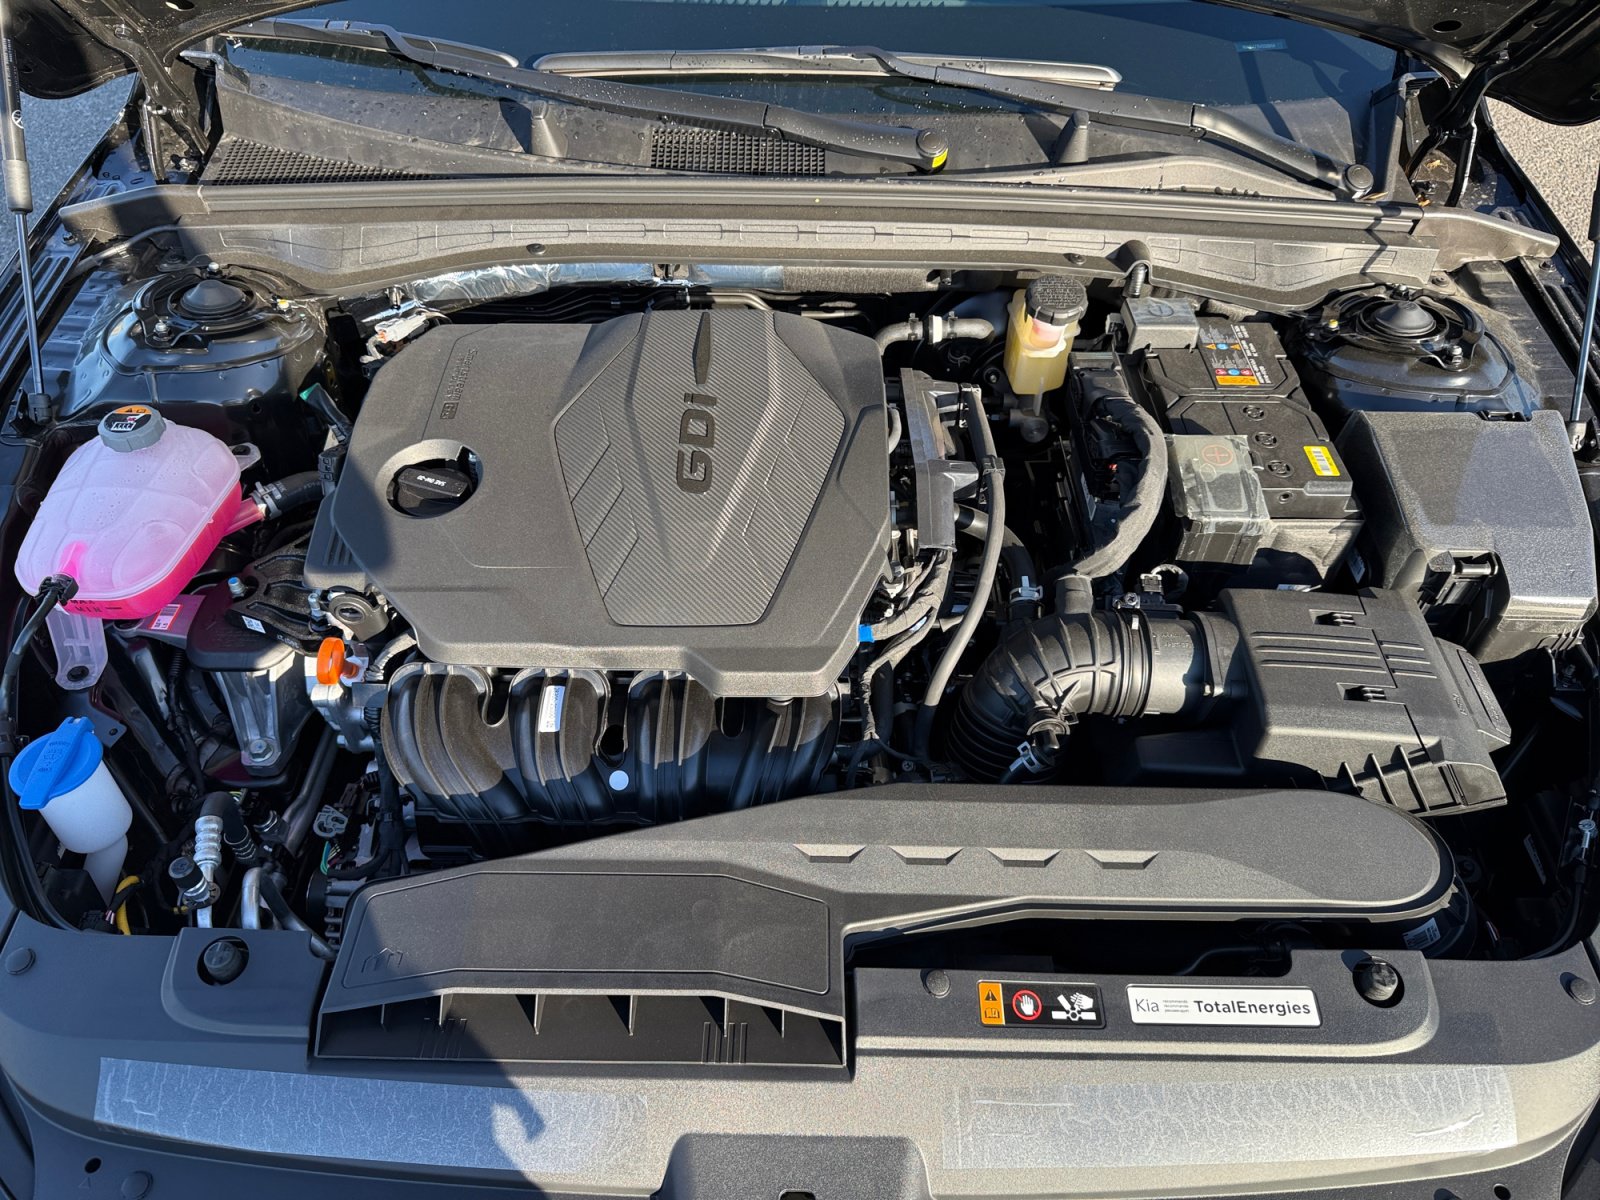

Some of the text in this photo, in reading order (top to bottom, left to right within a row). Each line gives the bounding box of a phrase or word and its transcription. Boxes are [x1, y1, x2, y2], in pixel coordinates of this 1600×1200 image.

[451, 347, 478, 400] Smartstream
[676, 392, 717, 493] GDi
[1135, 998, 1160, 1012] Kia
[1193, 1000, 1311, 1017] TotalEnergies
